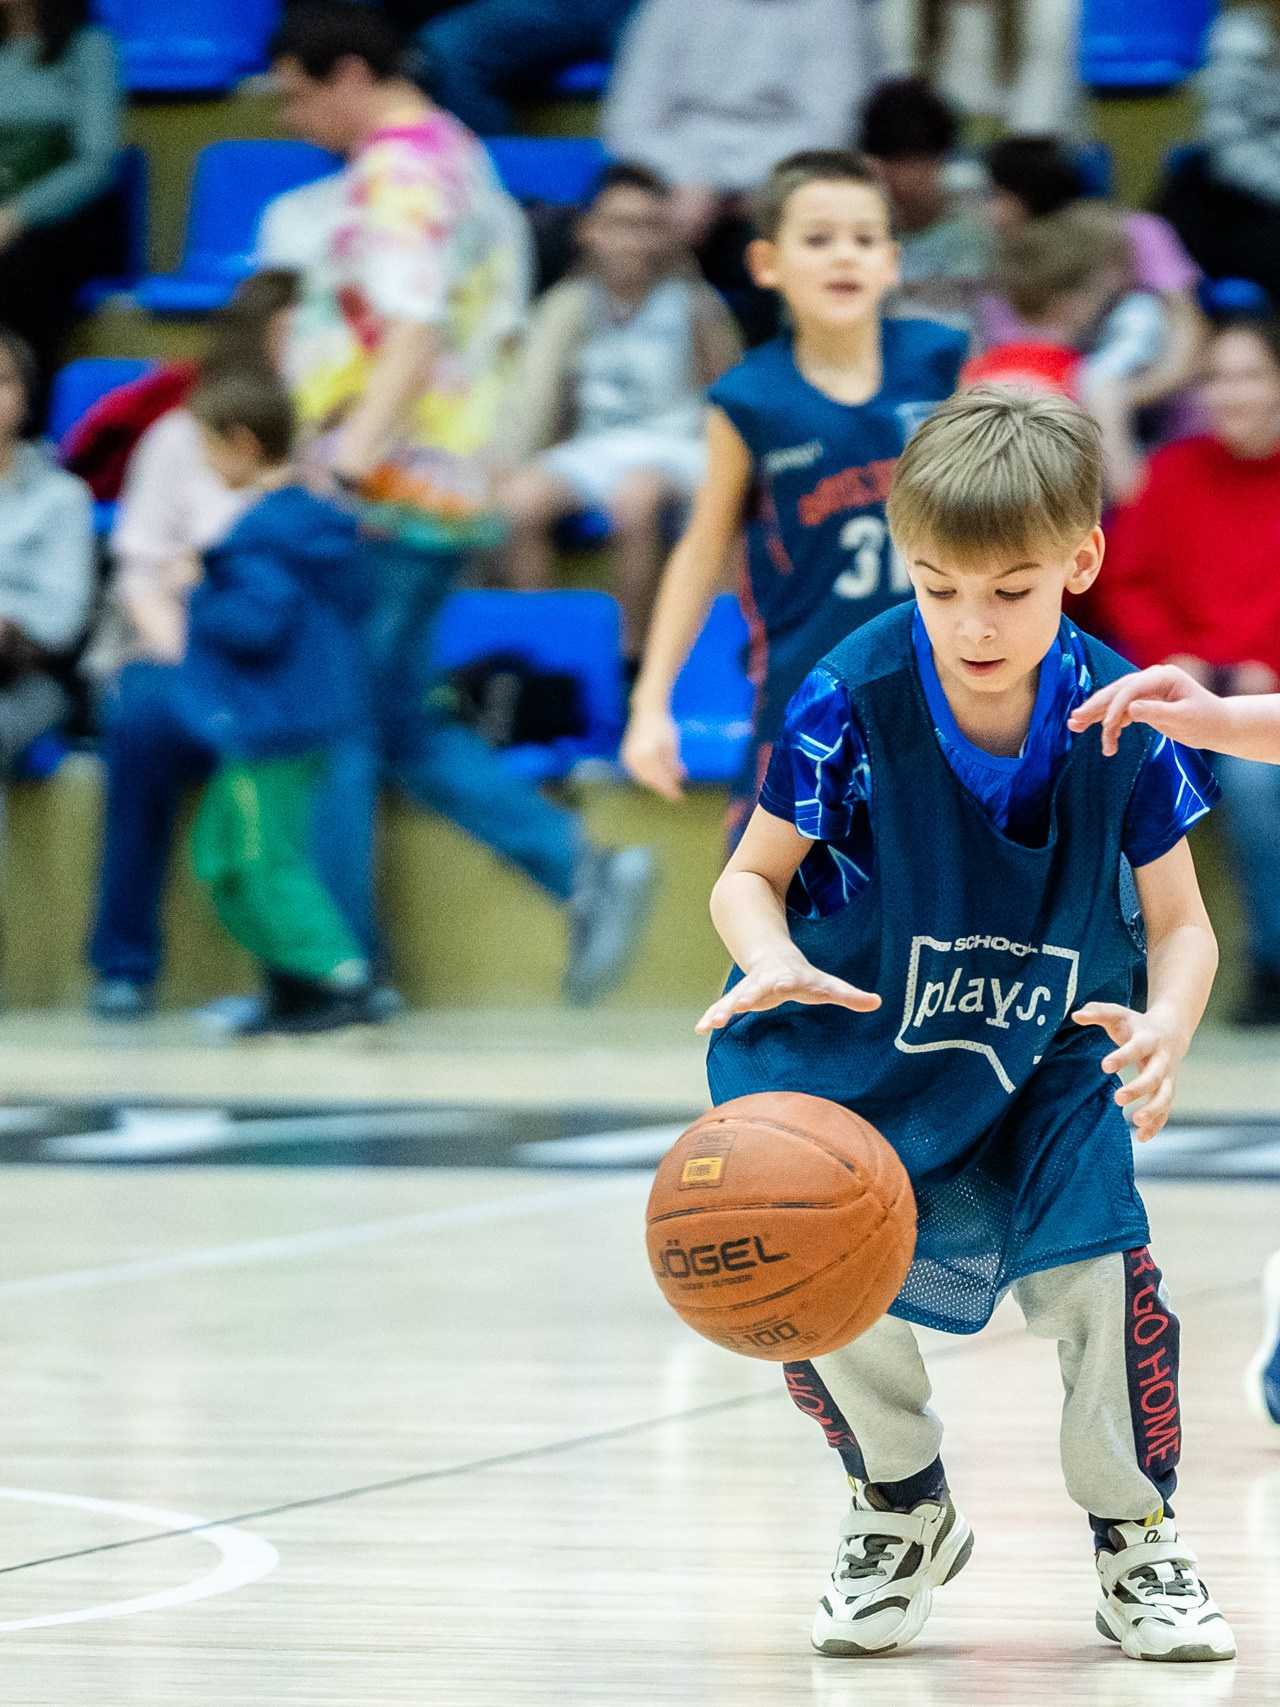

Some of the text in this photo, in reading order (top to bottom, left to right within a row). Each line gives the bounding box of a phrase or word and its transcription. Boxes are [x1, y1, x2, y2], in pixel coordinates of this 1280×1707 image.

[656, 1235, 790, 1278] JÖGEL
[1133, 1284, 1169, 1346] GO
[1137, 1347, 1180, 1468] HOME
